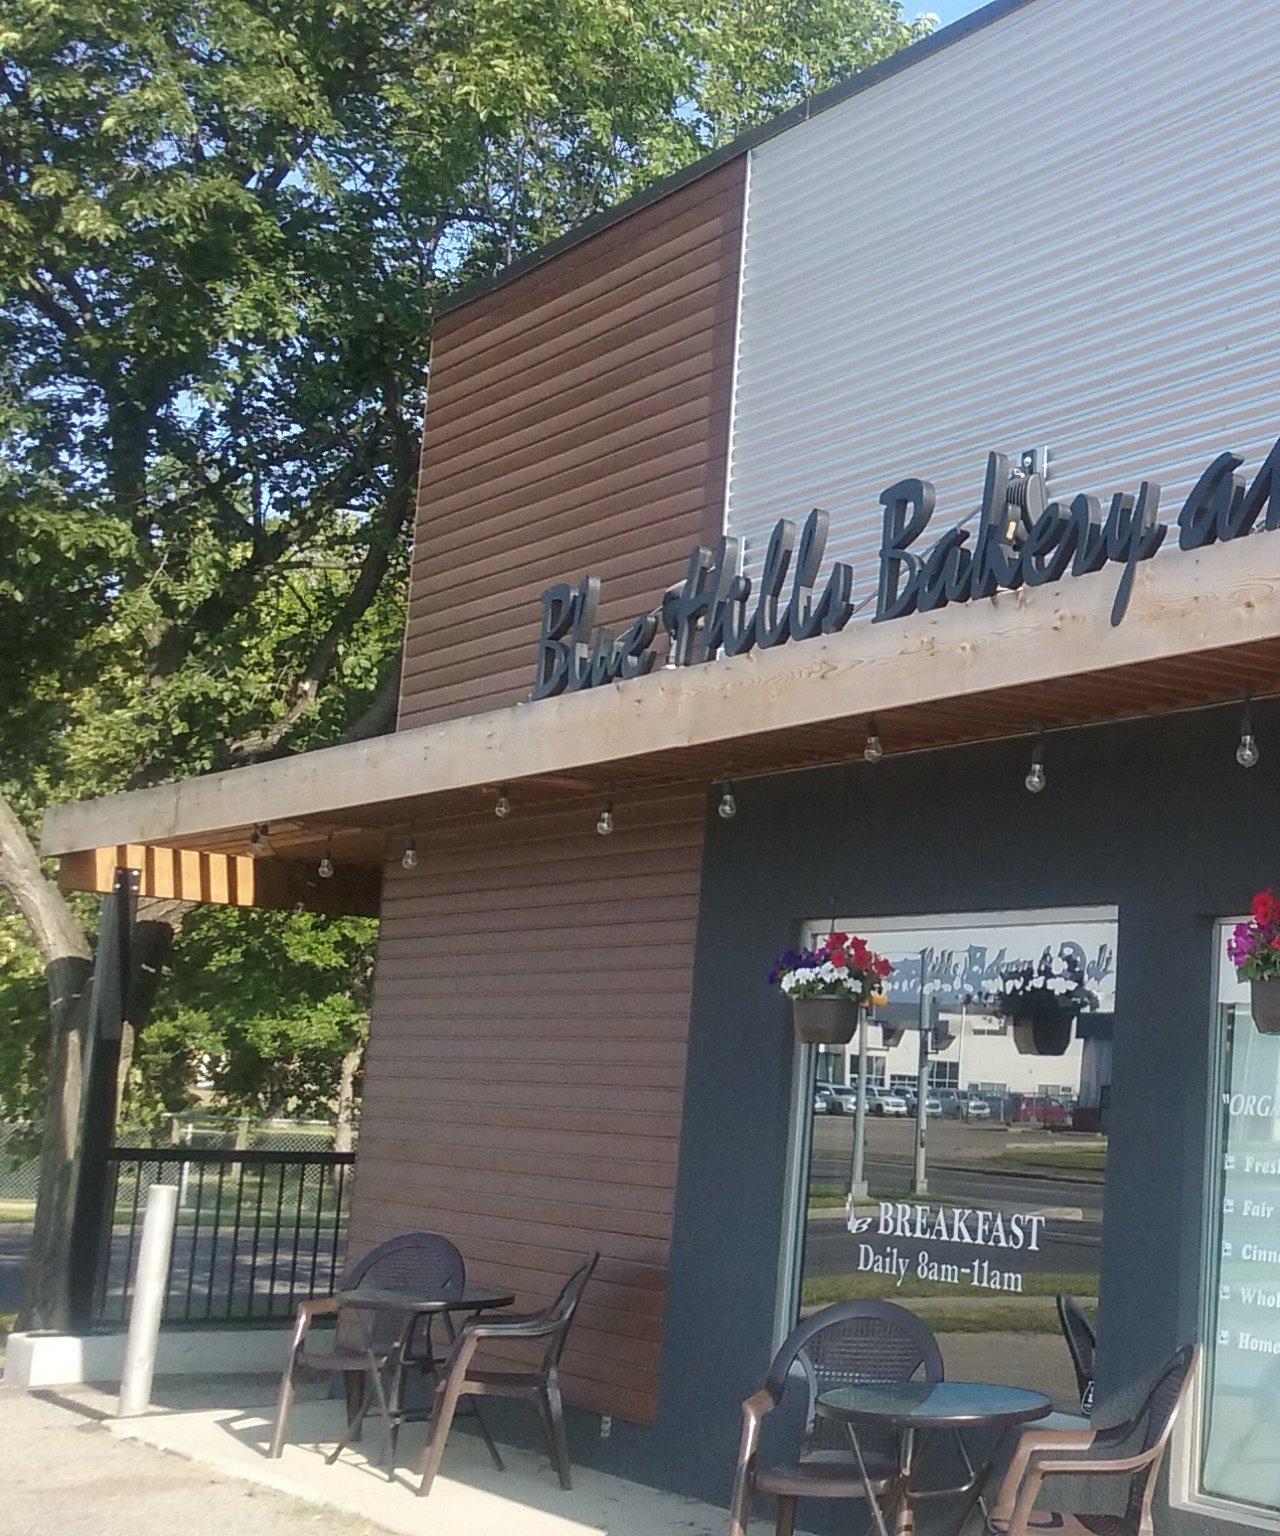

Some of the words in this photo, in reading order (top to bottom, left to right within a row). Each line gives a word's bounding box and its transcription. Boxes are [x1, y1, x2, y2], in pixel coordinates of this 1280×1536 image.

[533, 574, 657, 700] Blue
[662, 508, 854, 671] Hills
[871, 450, 1168, 627] Bakery
[877, 1201, 1046, 1251] BREAKFAST
[1242, 1201, 1274, 1219] Fair
[857, 1244, 911, 1287] Daily
[917, 1250, 1023, 1293] 8am-11am
